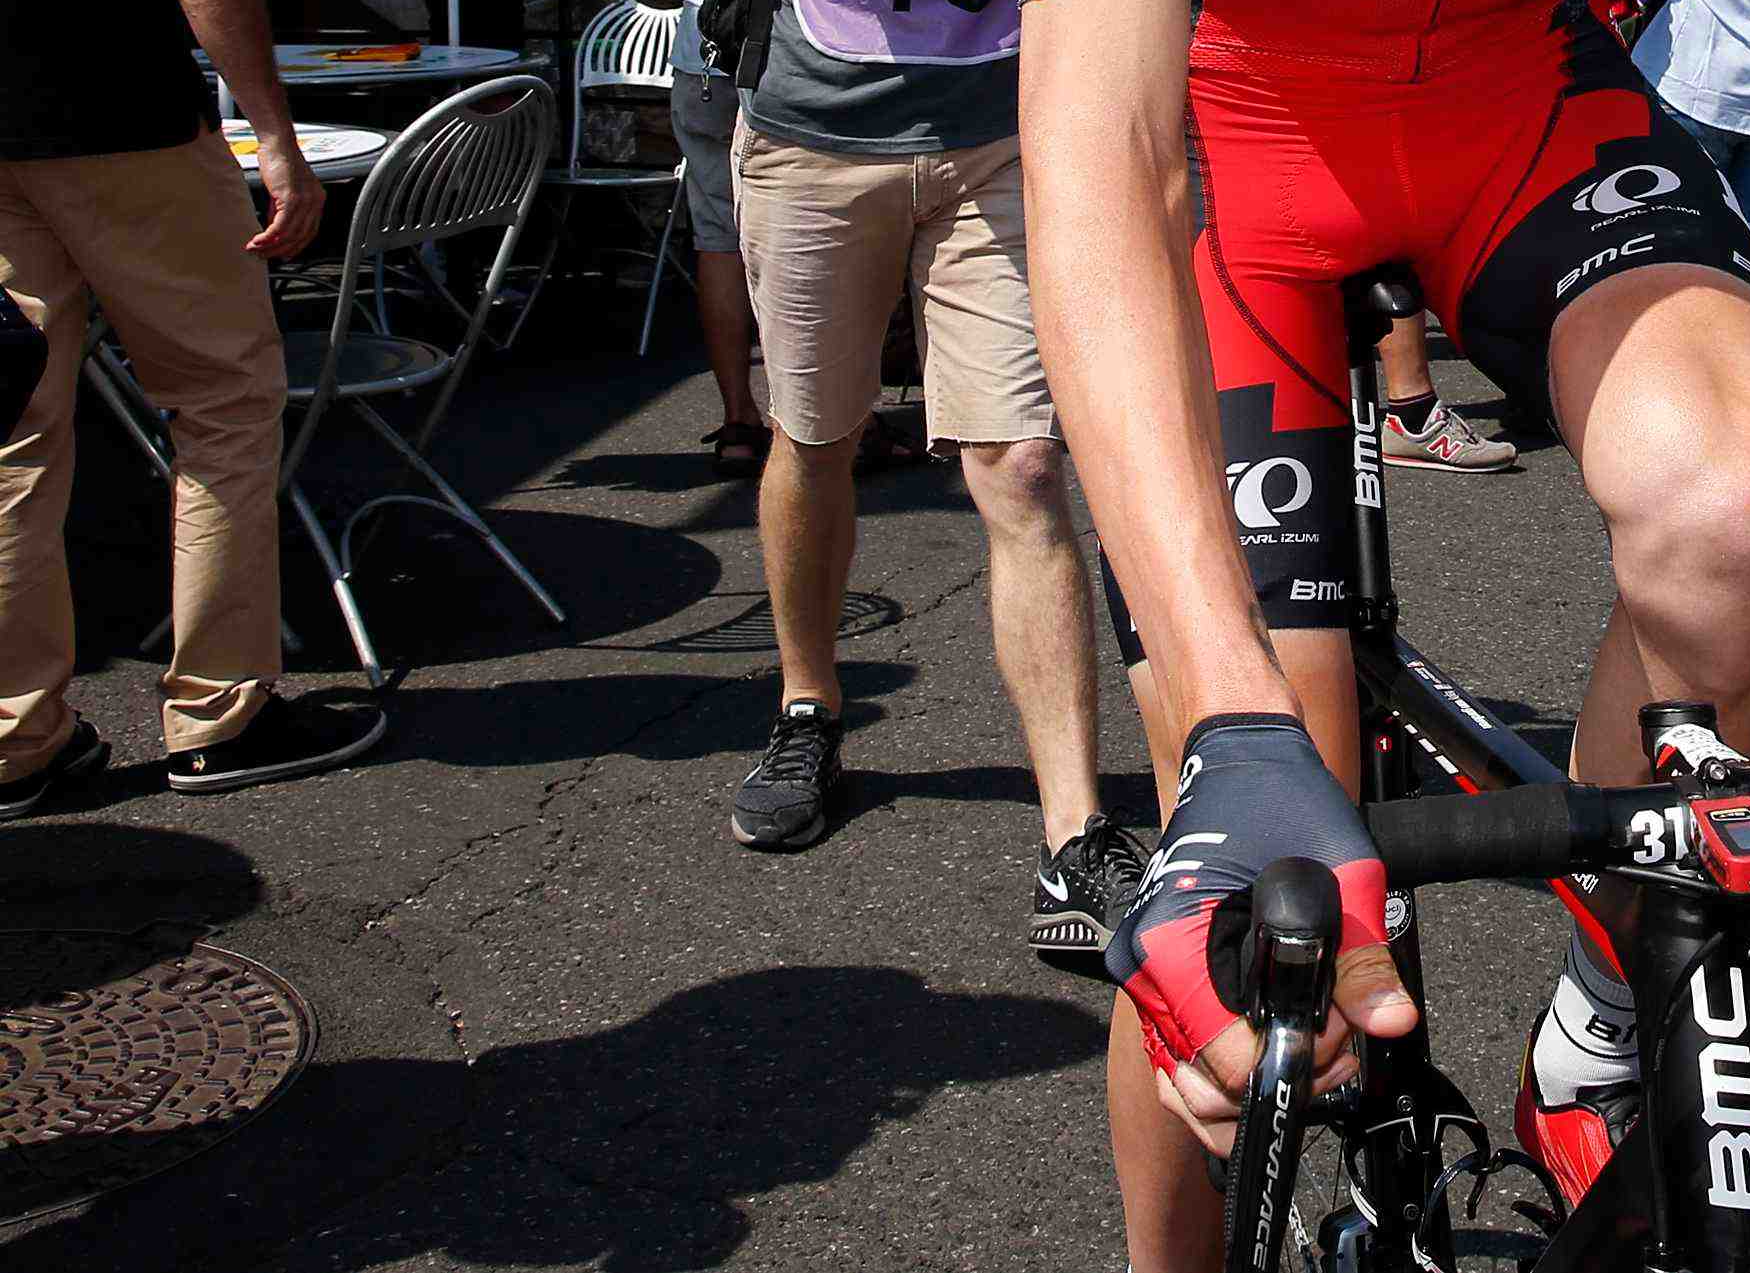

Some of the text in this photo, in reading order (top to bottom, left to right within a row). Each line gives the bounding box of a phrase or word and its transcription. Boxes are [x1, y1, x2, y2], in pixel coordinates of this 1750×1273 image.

[1590, 209, 1648, 231] PEARL
[1556, 233, 1655, 299] BMC
[1352, 399, 1381, 509] BMC
[1290, 579, 1345, 601] BMC
[1251, 1079, 1290, 1271] DURA-ACE
